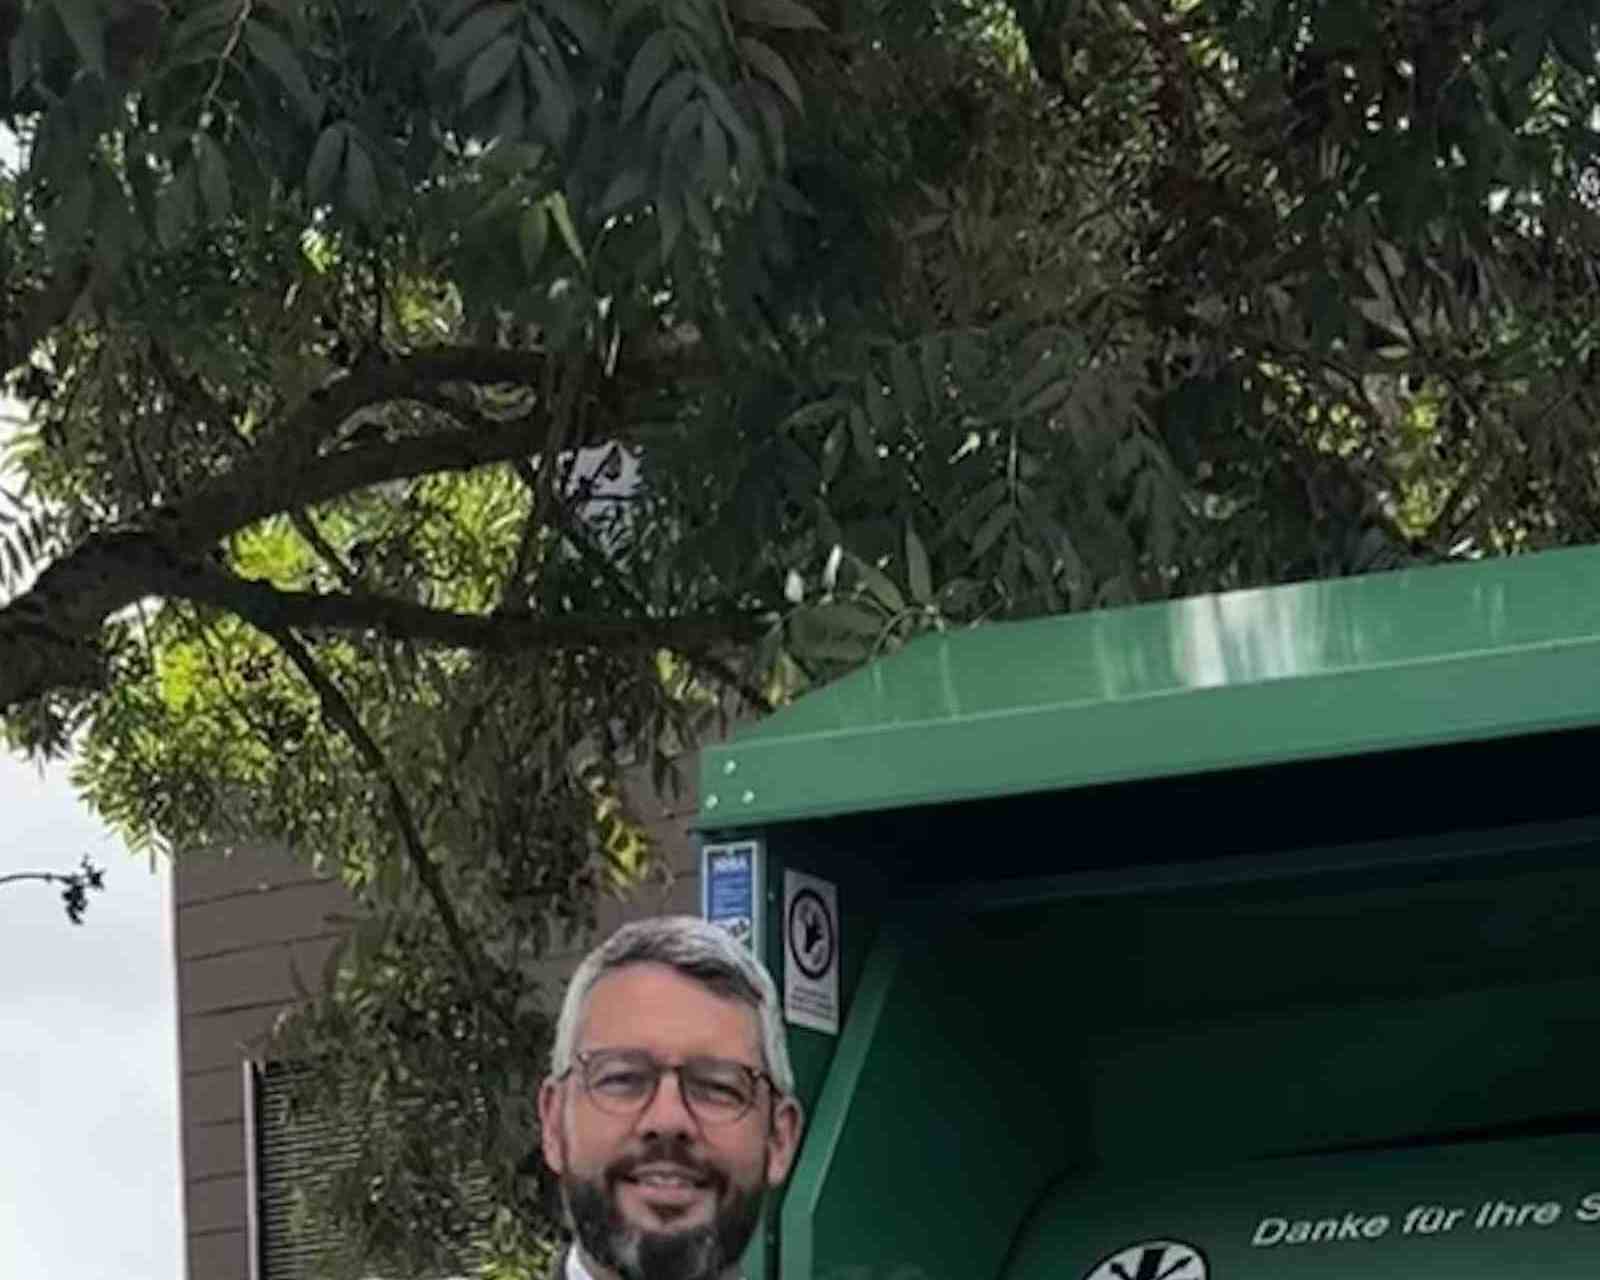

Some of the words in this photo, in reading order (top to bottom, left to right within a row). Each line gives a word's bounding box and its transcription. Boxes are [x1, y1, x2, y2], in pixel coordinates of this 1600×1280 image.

[1252, 1214, 1389, 1247] Danke
[1402, 1204, 1464, 1235] für
[1474, 1198, 1561, 1230] Ihre
